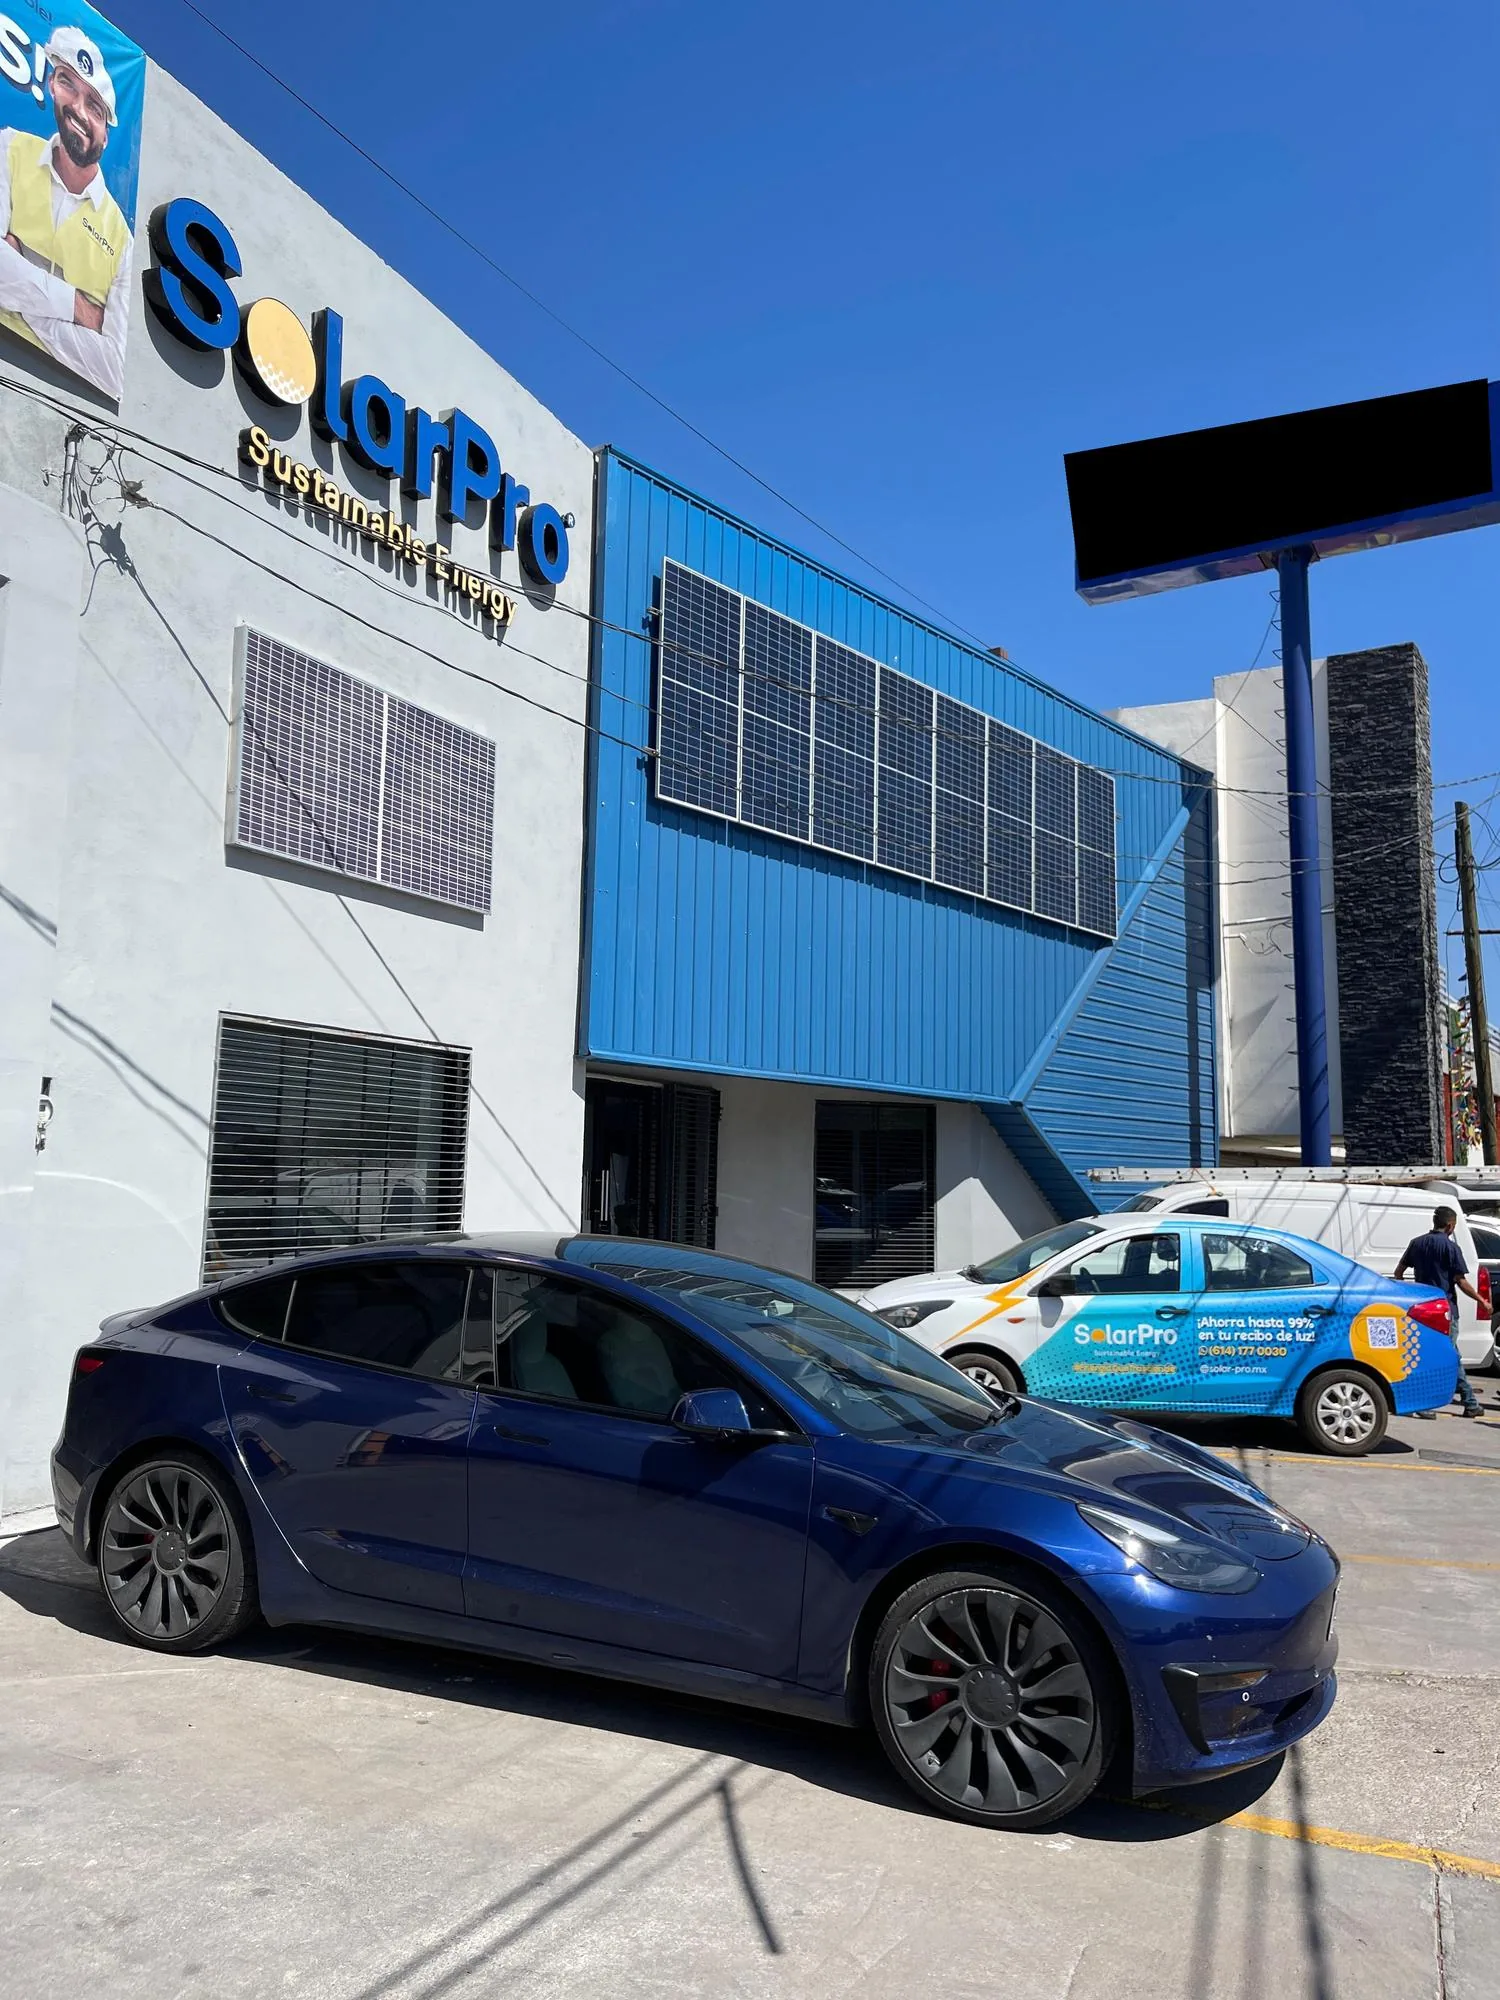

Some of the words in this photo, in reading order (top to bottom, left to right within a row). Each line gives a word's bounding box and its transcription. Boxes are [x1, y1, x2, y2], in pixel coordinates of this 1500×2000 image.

[82, 217, 115, 256] SolarPro
[143, 196, 571, 586] SolarPro
[248, 425, 428, 566] Sustainable
[435, 542, 518, 626] Energy
[1198, 1316, 1246, 1329] ¡Ahorra
[1248, 1316, 1285, 1328] hasta
[1288, 1317, 1315, 1329] 99%
[1074, 1323, 1178, 1345] SolarPro
[1198, 1331, 1214, 1340] en
[1218, 1330, 1232, 1341] tu
[1234, 1329, 1273, 1341] recibo
[1276, 1329, 1293, 1341] de
[1295, 1330, 1316, 1342] luz!
[1209, 1345, 1236, 1357] (614)
[1237, 1346, 1255, 1356] 177
[1256, 1346, 1288, 1357] 0030
[1209, 1365, 1267, 1374] solar-pro.mx
